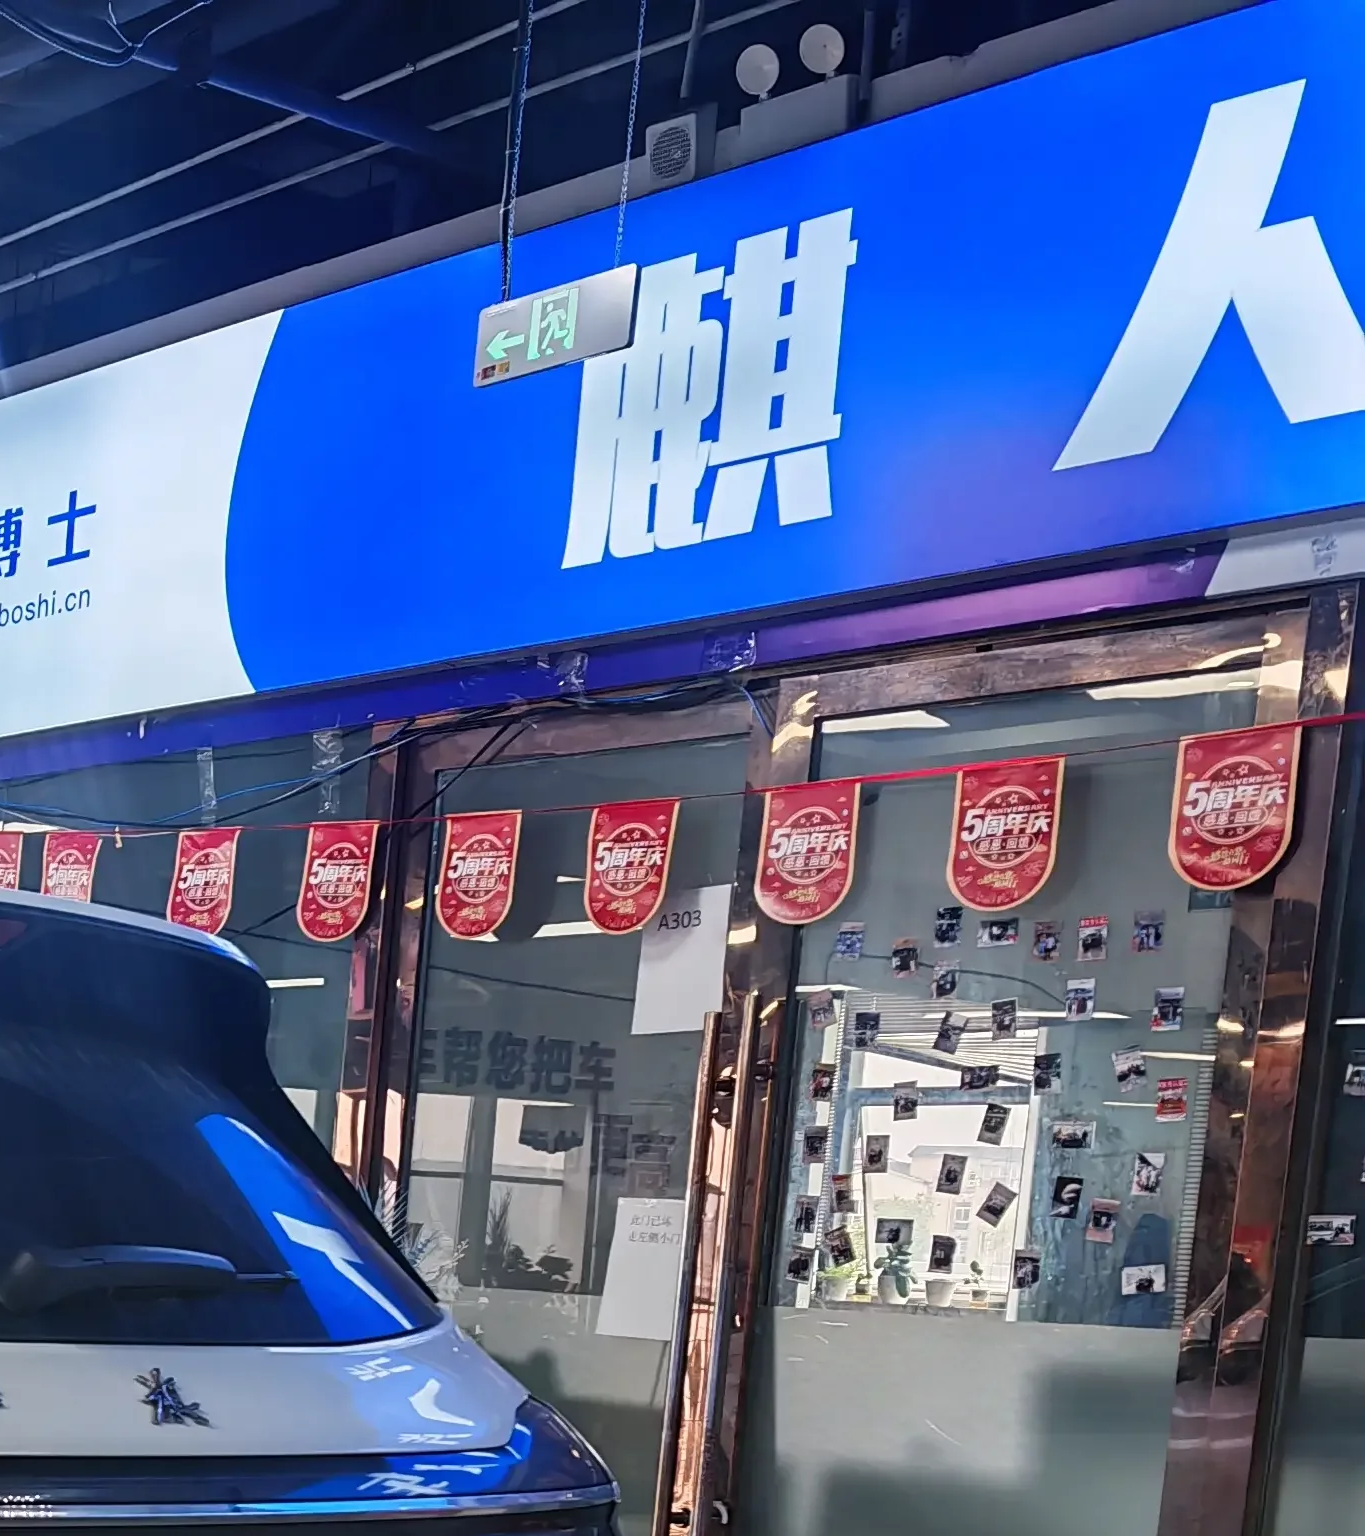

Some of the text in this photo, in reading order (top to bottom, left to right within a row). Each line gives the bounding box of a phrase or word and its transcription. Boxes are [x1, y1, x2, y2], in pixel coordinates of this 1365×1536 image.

[1183, 779, 1288, 817] 5周年庆
[961, 808, 1052, 842] 5周年庆
[594, 841, 666, 871] 5周年庆
[768, 827, 850, 859] 5周年庆
[309, 858, 367, 884] 5周年庆
[447, 851, 512, 879] 5周年庆
[657, 909, 702, 931] A303
